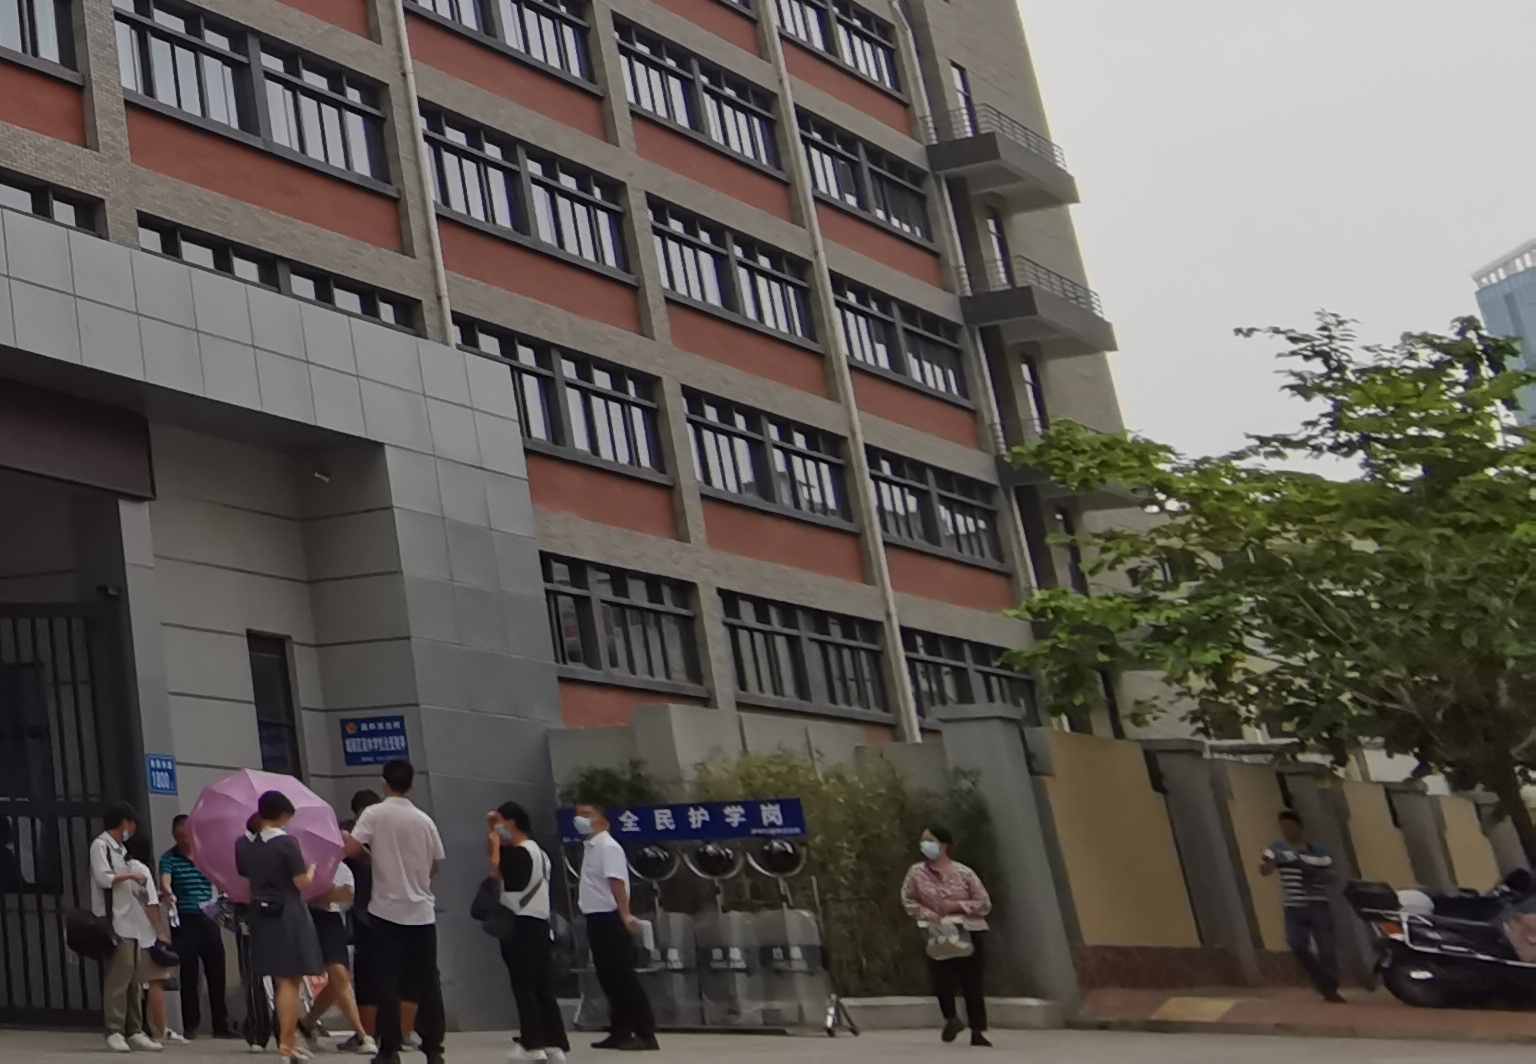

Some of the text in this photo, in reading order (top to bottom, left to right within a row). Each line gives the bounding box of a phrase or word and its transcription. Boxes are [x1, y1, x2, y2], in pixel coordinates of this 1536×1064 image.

[618, 803, 784, 832] 全民护学岗
